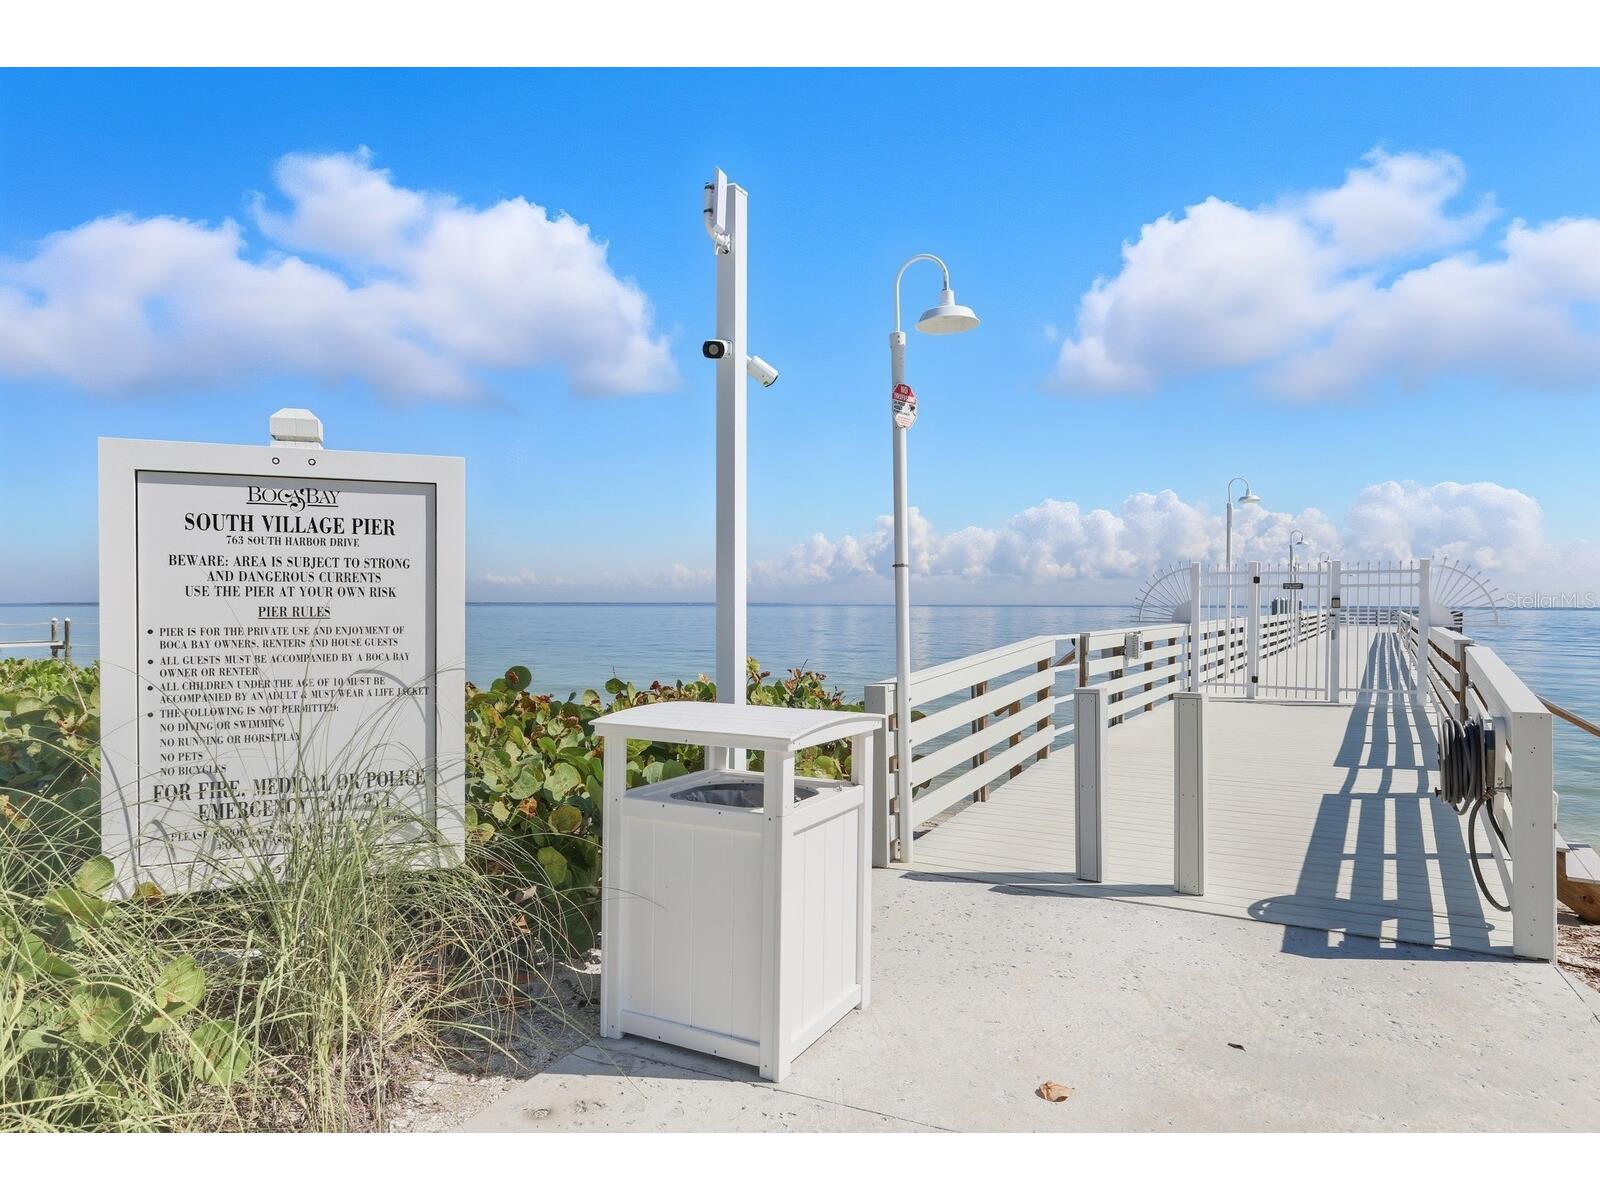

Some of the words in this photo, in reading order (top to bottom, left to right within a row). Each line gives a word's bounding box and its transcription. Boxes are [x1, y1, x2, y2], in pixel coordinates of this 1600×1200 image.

[248, 486, 302, 503] BOCA
[306, 488, 340, 504] BAY
[184, 513, 254, 532] SOUTH
[262, 515, 345, 535] VILLAGE
[352, 518, 395, 536] PIER
[227, 535, 244, 545] 763
[247, 536, 282, 546] SOUTH
[285, 537, 327, 547] HARBOR
[329, 538, 360, 547] DRIVE
[169, 554, 229, 567] BEWARE:
[233, 556, 267, 568] AREA
[271, 556, 283, 568] IS
[286, 557, 340, 569] SUBJECT
[344, 557, 360, 569] TO
[363, 558, 411, 569] STRONG
[207, 571, 234, 582] AND
[238, 571, 315, 583] DANGEROUS
[319, 572, 382, 583] CURRENTS
[185, 586, 210, 597] USE
[214, 586, 241, 597] THE
[245, 586, 275, 598] PIER
[279, 586, 297, 598] AT
[300, 586, 333, 598] YOUR
[337, 586, 366, 598] OWN
[369, 586, 397, 598] RISK
[258, 606, 287, 618] PIER
[292, 606, 331, 618] RULES
[160, 627, 184, 636] PIER
[187, 627, 196, 636] IS
[200, 627, 220, 636] FOR
[223, 627, 244, 636] THE
[247, 627, 289, 636] PRIVATE
[292, 626, 310, 635] USE
[314, 626, 332, 635] AND
[335, 626, 390, 635] ENJOYMENT
[392, 626, 405, 634] OF
[160, 640, 187, 649] BOCA
[191, 640, 211, 649] BAY
[262, 639, 306, 648] RENTERS
[310, 639, 328, 647] AND
[331, 638, 362, 647] HOUSE
[364, 638, 398, 647] GUESTS
[160, 656, 179, 665] ALL
[183, 656, 220, 665] GUESTS
[224, 655, 251, 664] MUST
[254, 655, 267, 663] BE
[270, 653, 338, 664] ACCOMPANIED
[342, 653, 353, 662] BY
[357, 653, 363, 661] A
[366, 653, 390, 661] BOCA
[393, 652, 410, 661] BAY
[160, 668, 198, 678] OWNER
[201, 668, 215, 677] OR
[219, 667, 258, 676] RENTER
[160, 682, 179, 691] ALL
[182, 681, 234, 691] CHILDREN
[237, 680, 271, 689] UNDER
[273, 680, 293, 688] THE
[297, 679, 314, 687] AGE
[317, 678, 330, 687] OF
[333, 678, 343, 687] 10
[346, 677, 371, 686] MUST
[373, 677, 385, 685] BE
[160, 693, 231, 703] ACCOMPANIED
[235, 692, 247, 701] BY
[250, 692, 263, 701] AN
[268, 691, 298, 700] ADULT
[311, 690, 336, 698] MUST
[338, 689, 364, 698] WEAR
[367, 689, 372, 697] A
[375, 688, 394, 697] LIFE
[160, 709, 181, 718] THE
[184, 707, 244, 718] FOLLOWING
[247, 706, 256, 715] IS
[259, 705, 279, 715] NOT
[160, 723, 175, 732] NO
[178, 721, 213, 732] DIVING
[216, 721, 231, 730] OR
[233, 719, 285, 730] SWIMMING
[160, 738, 175, 748] NO
[227, 735, 241, 744] OR
[244, 732, 300, 744] HORSEPLAY
[160, 753, 175, 762] NO
[178, 751, 204, 761] PETS
[160, 767, 175, 777] NO
[153, 783, 191, 802] FOR
[198, 780, 246, 800] FIRE,
[366, 769, 425, 789] POLICE
